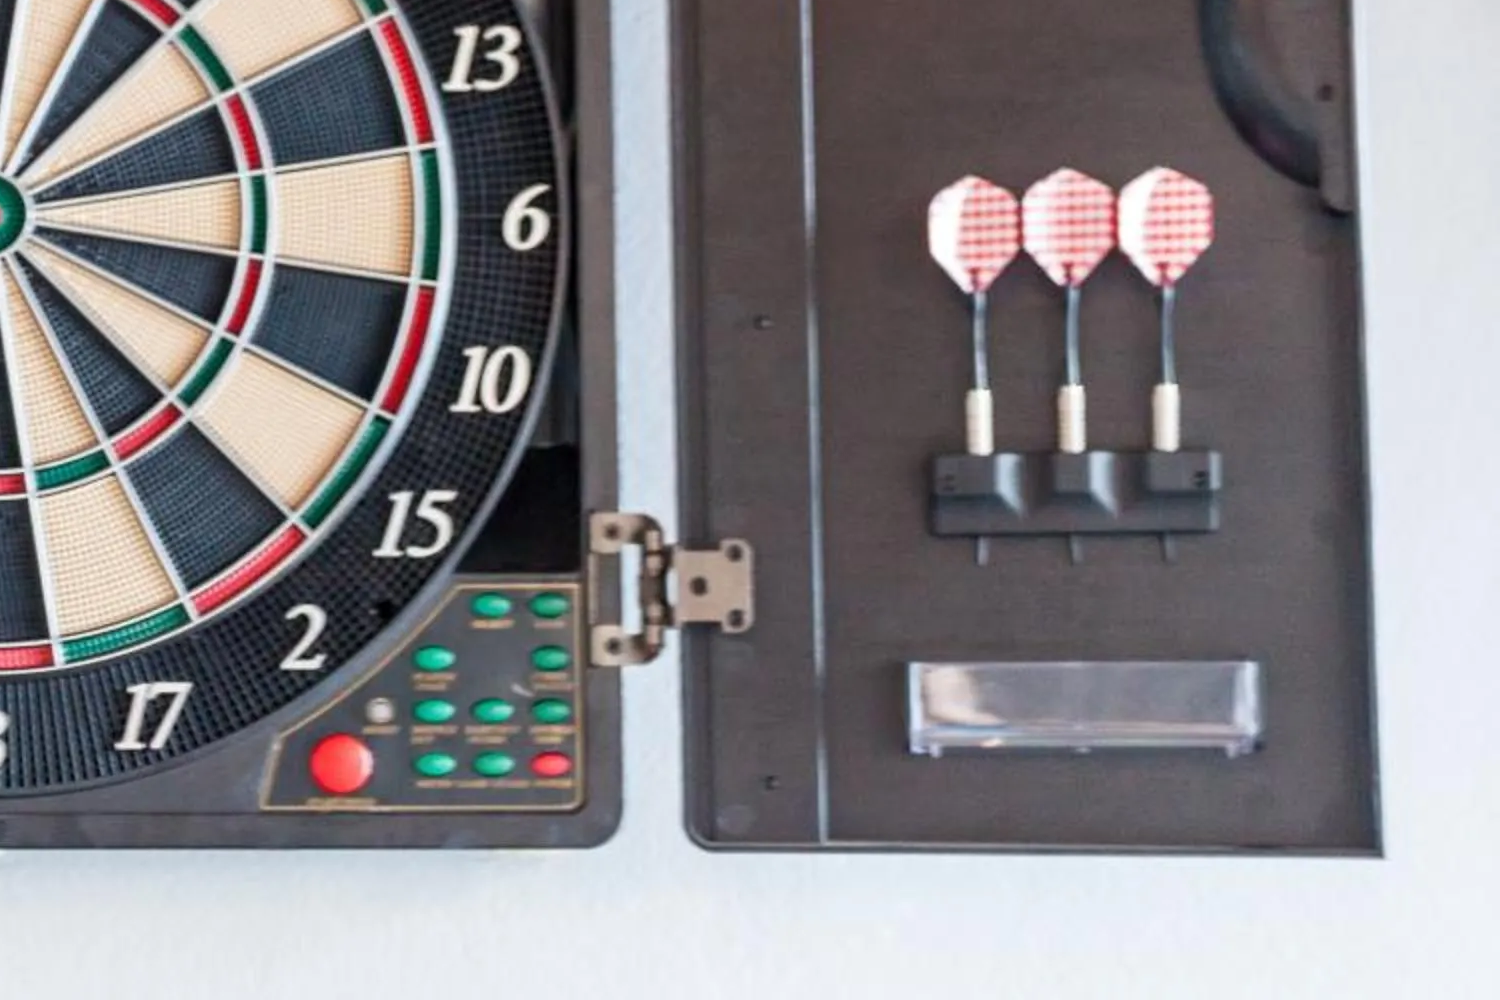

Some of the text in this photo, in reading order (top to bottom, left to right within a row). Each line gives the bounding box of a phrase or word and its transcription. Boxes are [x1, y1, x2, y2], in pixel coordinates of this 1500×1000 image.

[441, 24, 521, 92] 13
[502, 184, 550, 251] 6
[448, 345, 531, 414] 10
[371, 489, 459, 558] 15
[279, 603, 327, 671] 2
[113, 680, 194, 751] 17
